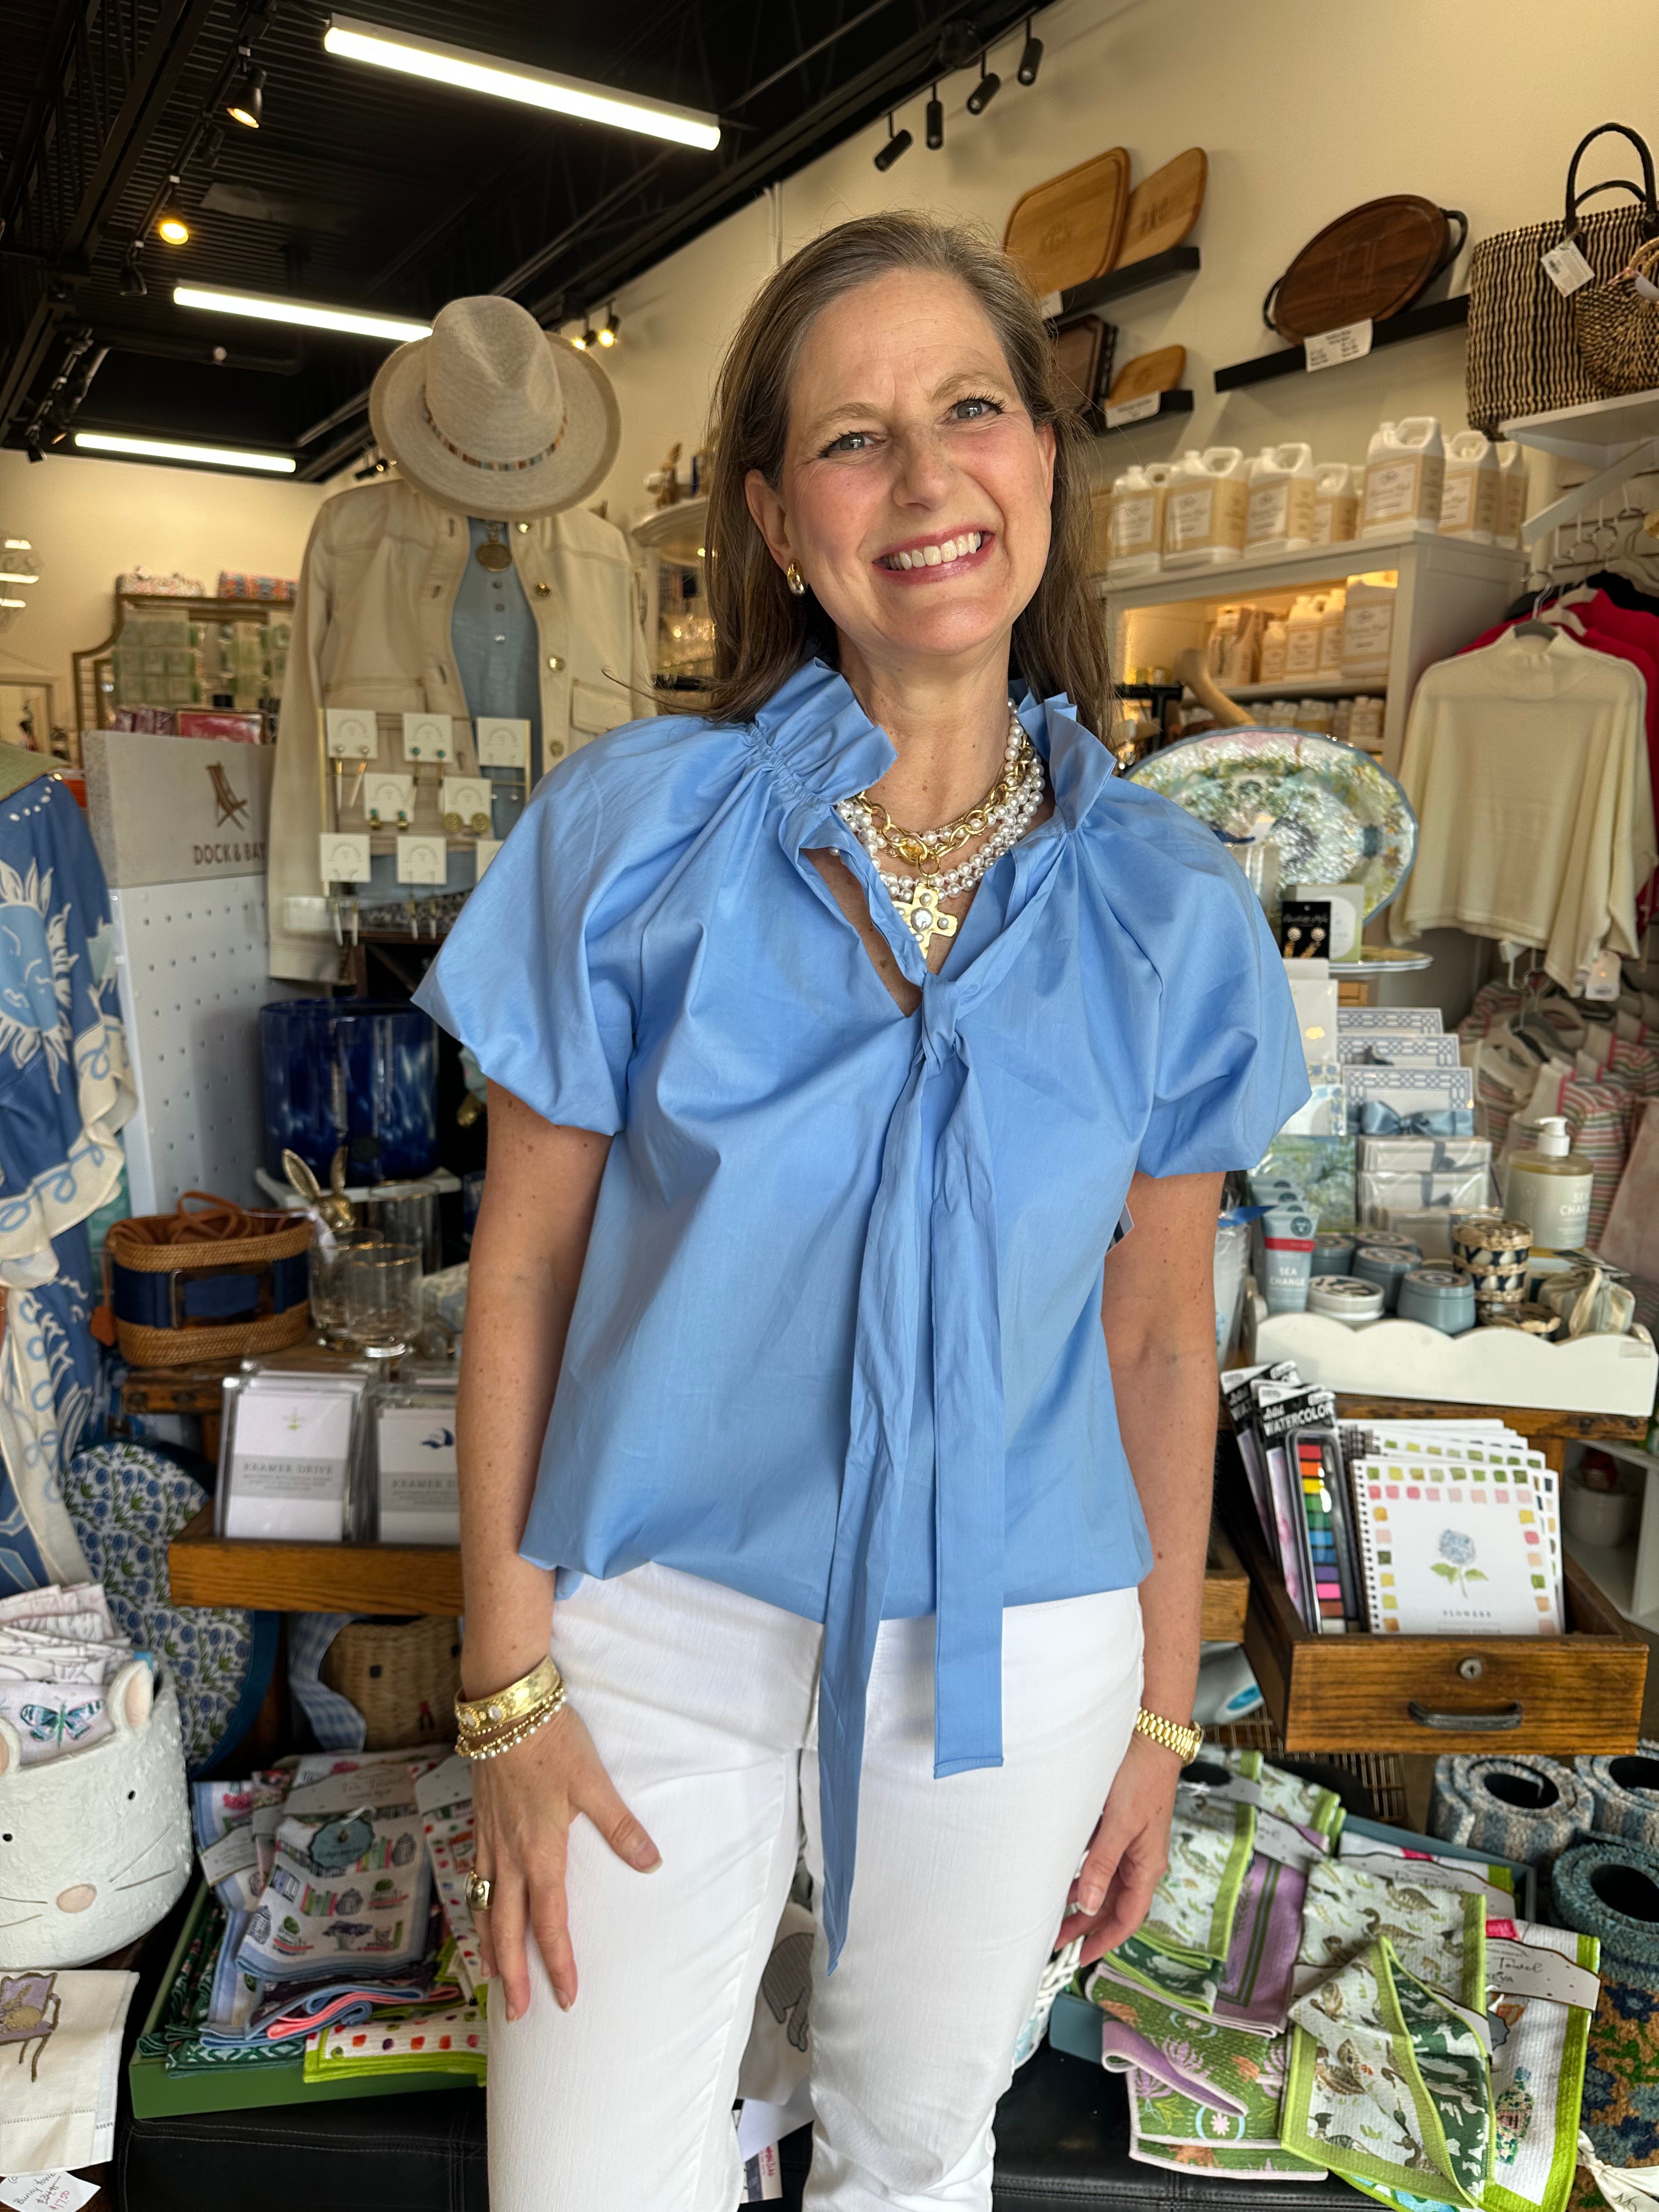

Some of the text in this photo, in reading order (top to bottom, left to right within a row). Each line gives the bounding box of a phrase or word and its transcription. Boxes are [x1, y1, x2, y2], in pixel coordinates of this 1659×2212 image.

[193, 843, 231, 864] DOCK
[233, 843, 241, 862] &
[1279, 1266, 1298, 1276] SEA
[1269, 1277, 1305, 1287] CHANGE
[1263, 1400, 1336, 1437] WATERCOLOR
[244, 1462, 334, 1475] KRAMER DRIVE
[1442, 1609, 1492, 1618] FLOWERS
[13, 2186, 43, 2205] Bunny
[33, 2173, 55, 2186] towe
[49, 2190, 70, 2210] $17.50
